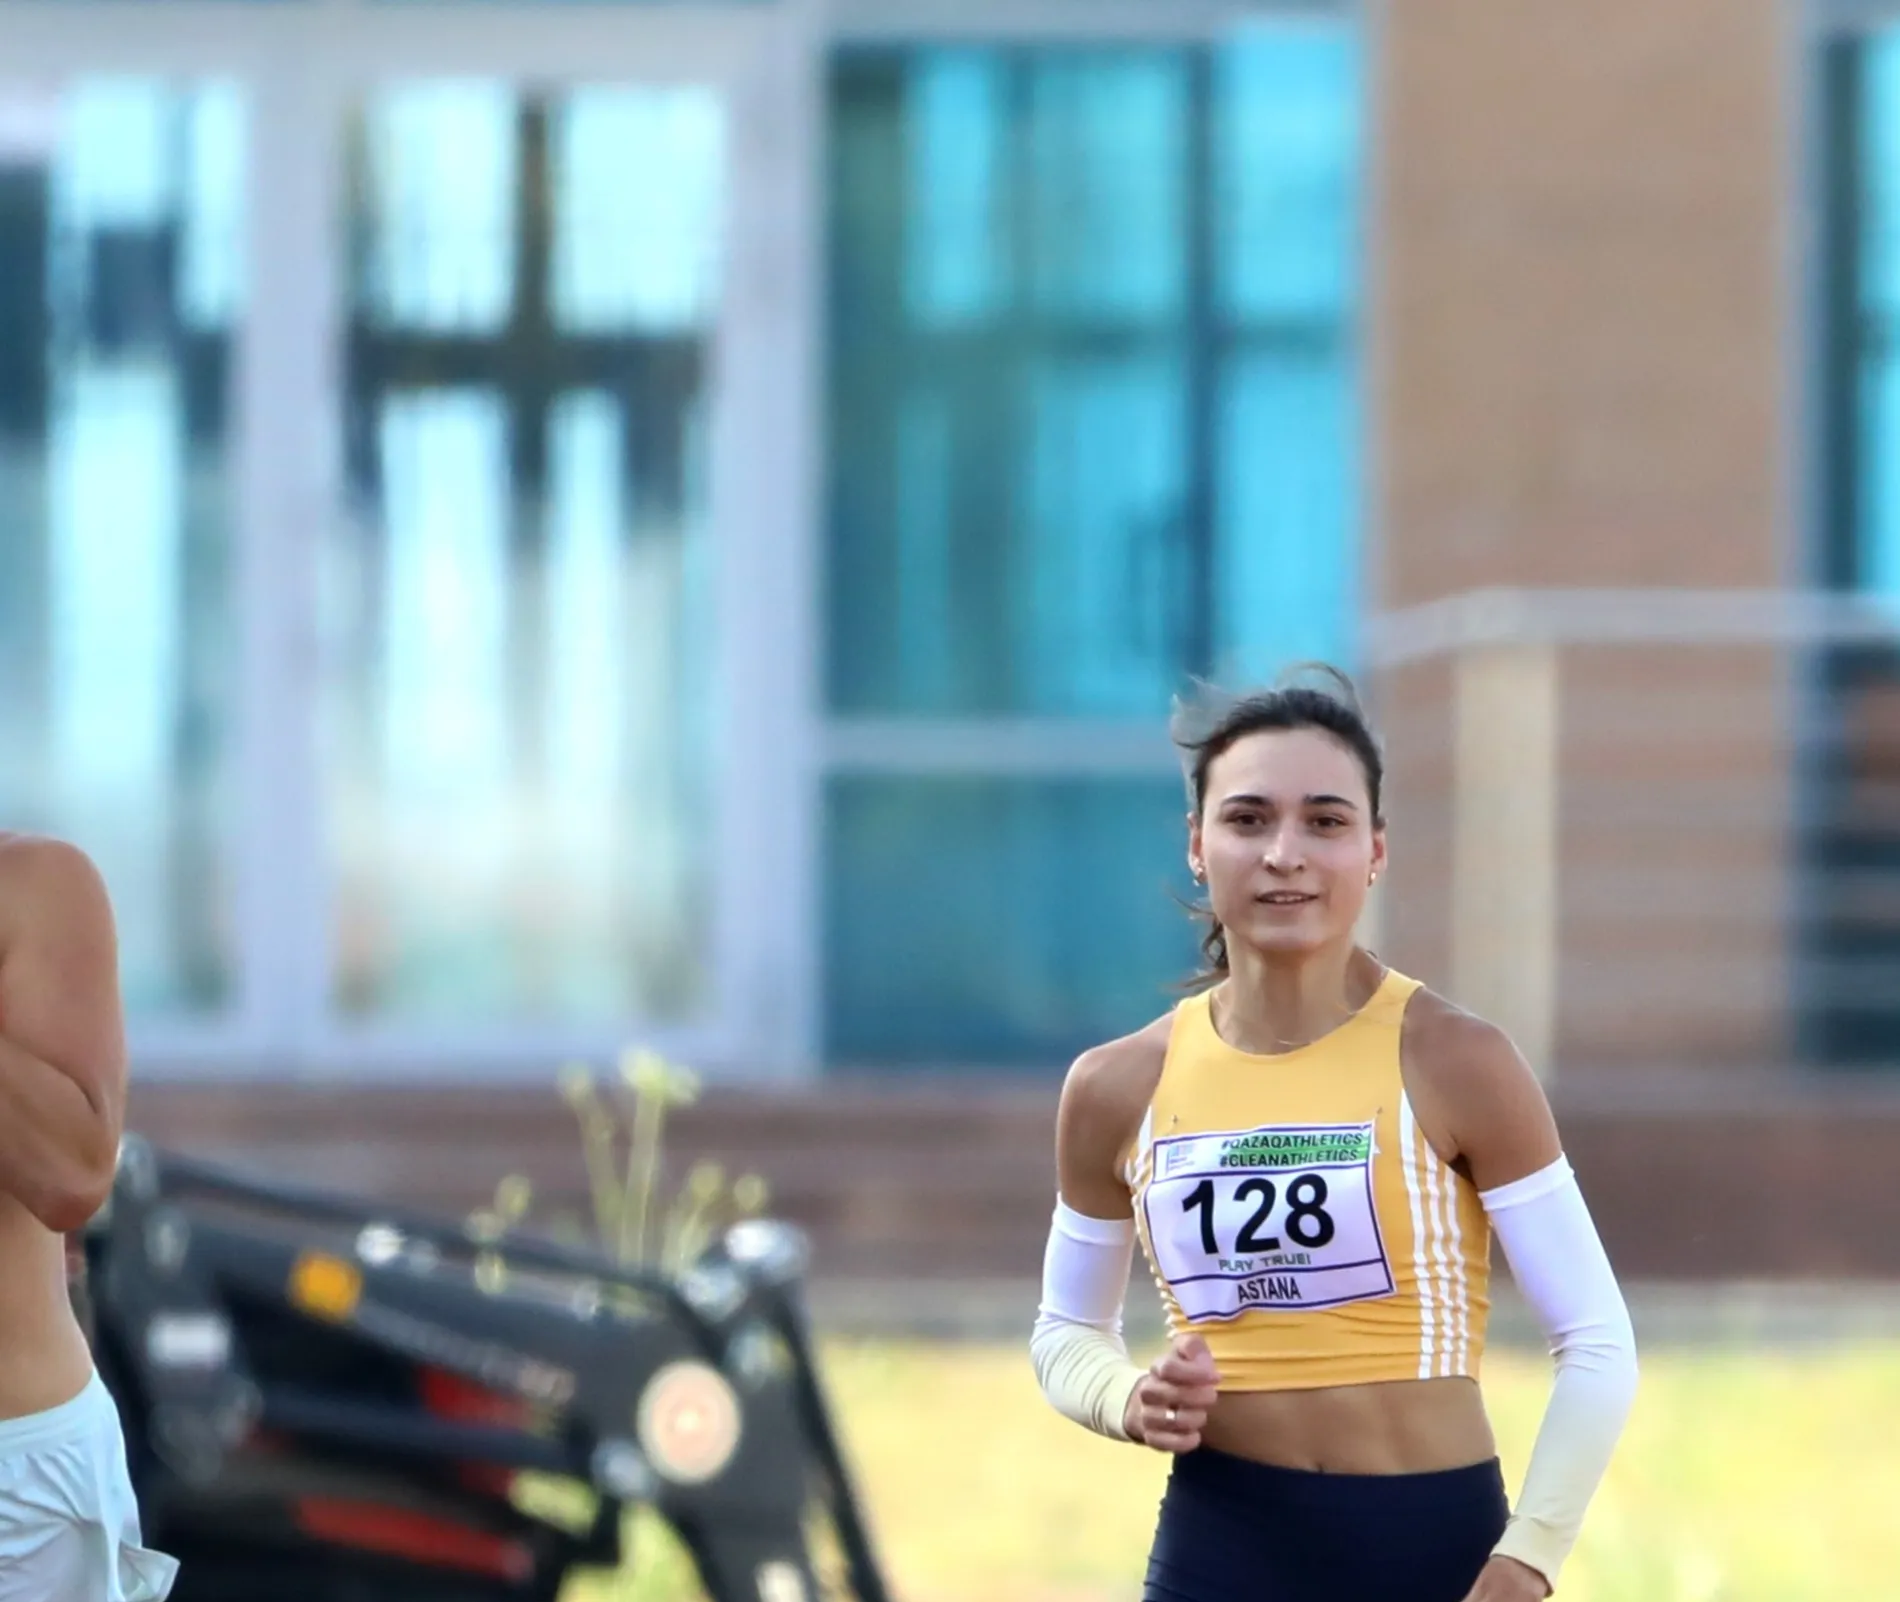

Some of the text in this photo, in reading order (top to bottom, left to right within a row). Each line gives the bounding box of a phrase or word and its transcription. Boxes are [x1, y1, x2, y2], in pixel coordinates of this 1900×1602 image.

[1221, 1133, 1364, 1150] #QAZAQATHLETICS
[1219, 1149, 1359, 1168] #CLEANATHLETICS
[1182, 1173, 1335, 1255] 128
[1218, 1252, 1312, 1273] PLAY TRUE!
[1237, 1277, 1302, 1303] ASTANA
